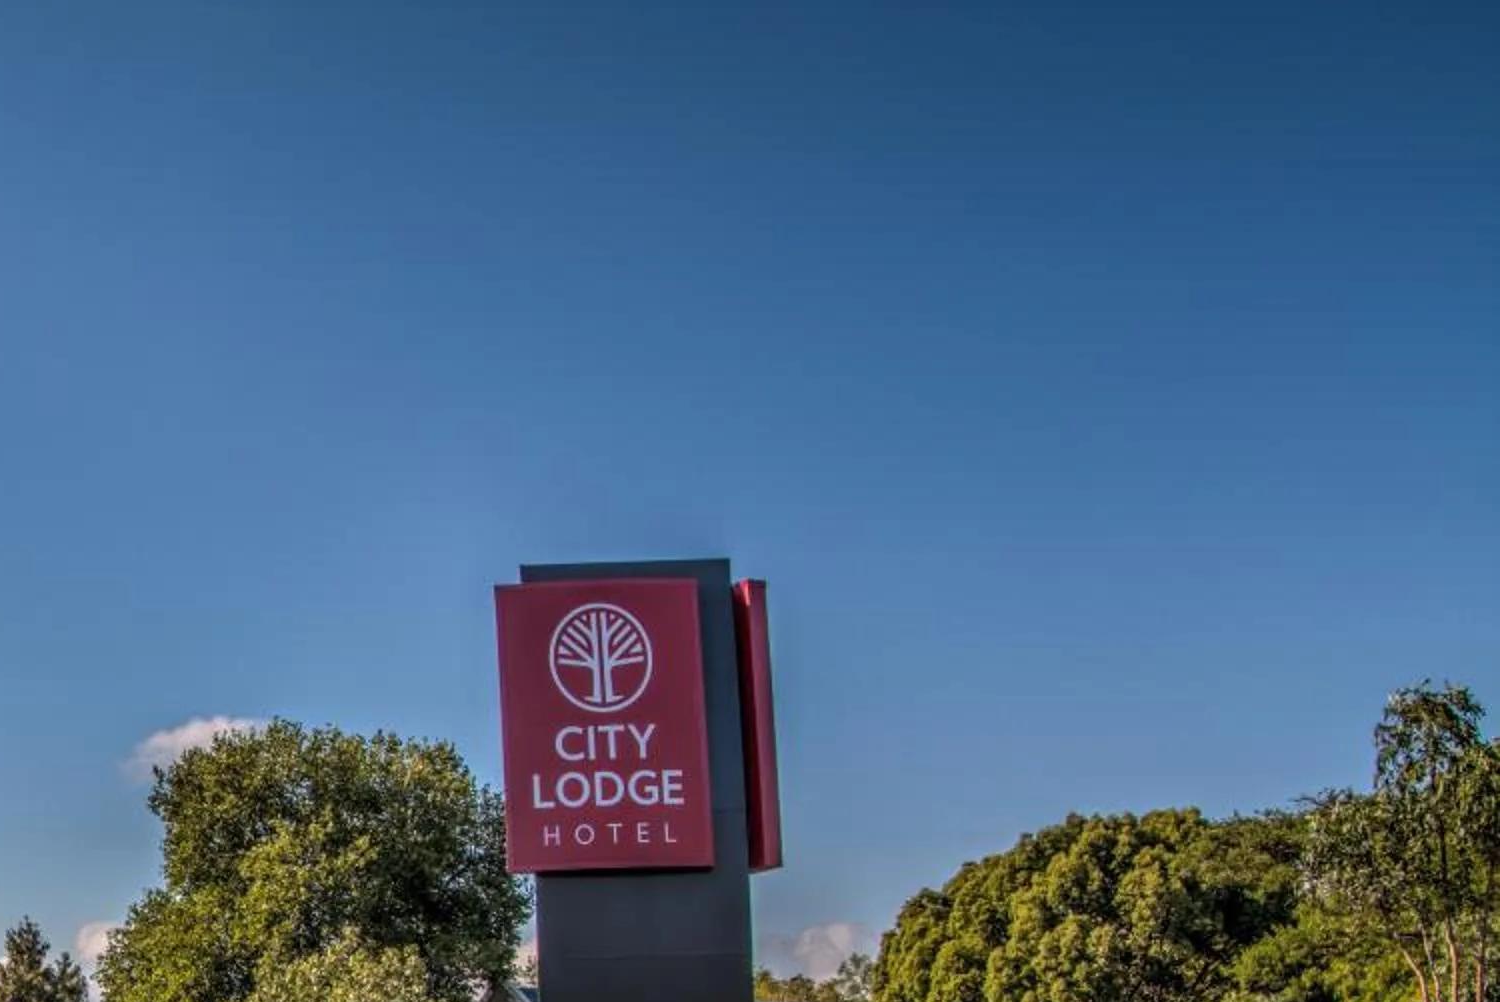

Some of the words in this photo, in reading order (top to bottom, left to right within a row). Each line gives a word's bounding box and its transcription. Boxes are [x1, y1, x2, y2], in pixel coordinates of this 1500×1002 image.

[555, 724, 656, 761] CITY
[532, 769, 685, 809] LODGE
[544, 823, 677, 846] HOTEL
